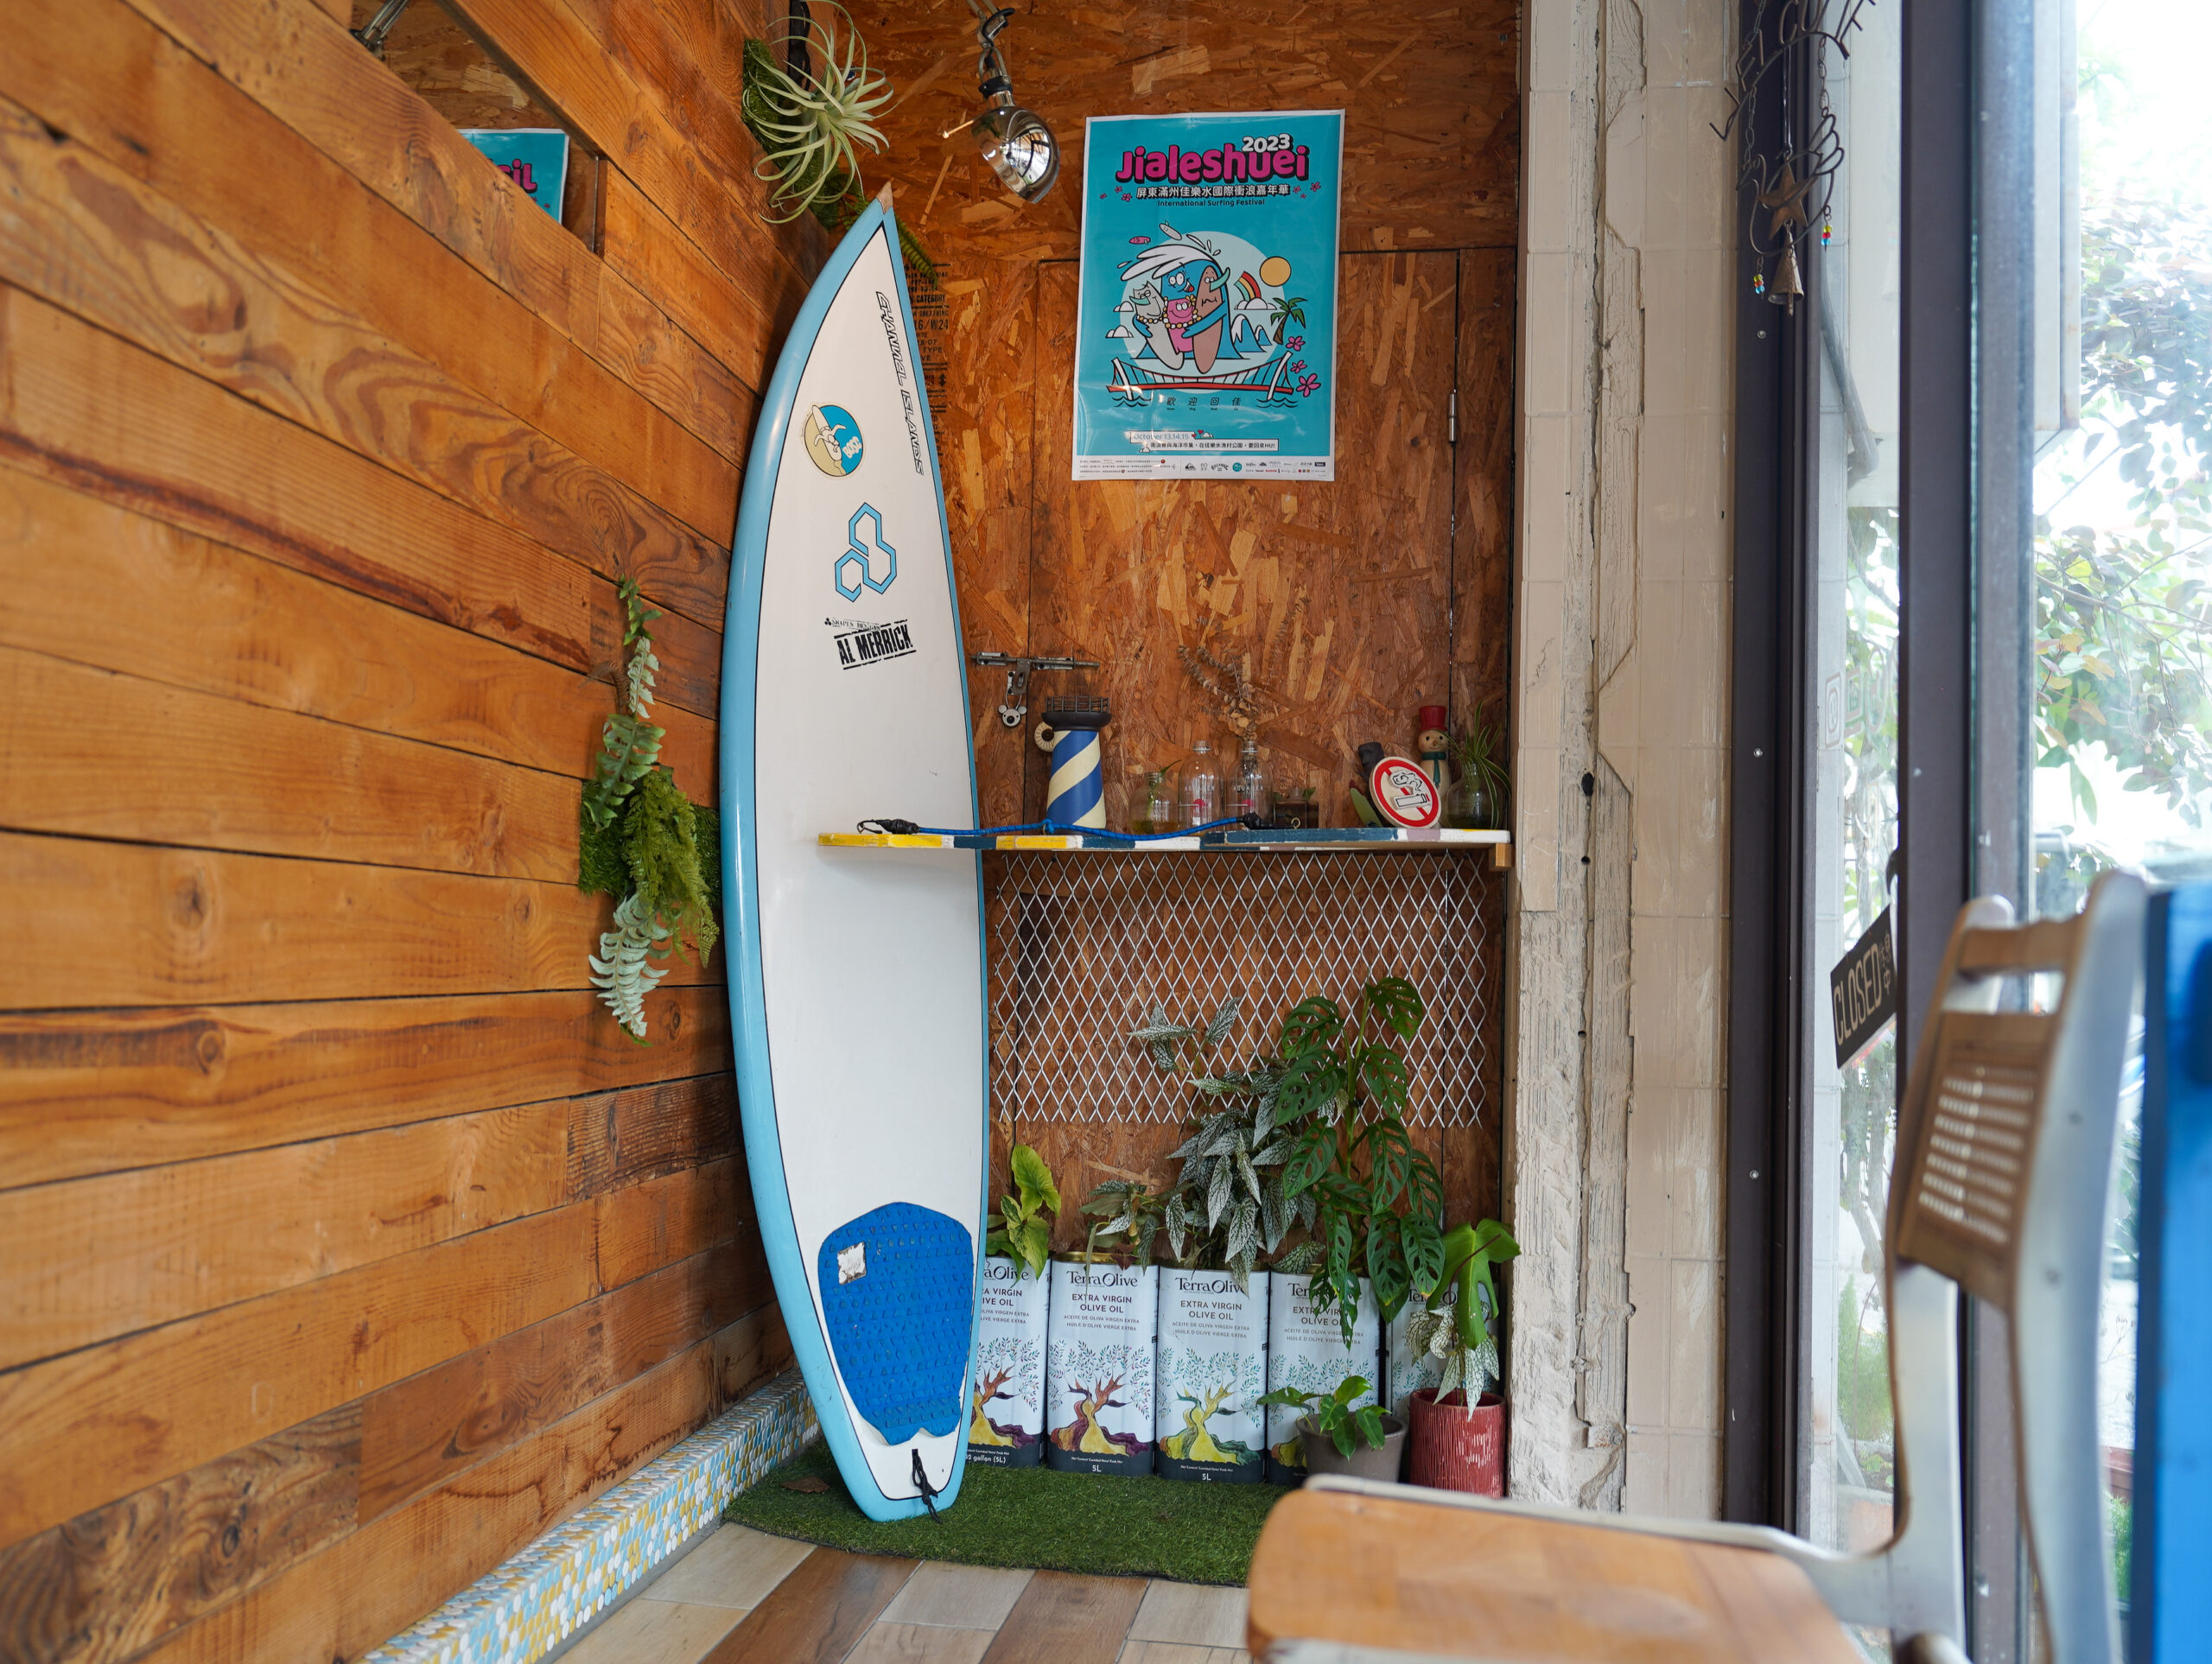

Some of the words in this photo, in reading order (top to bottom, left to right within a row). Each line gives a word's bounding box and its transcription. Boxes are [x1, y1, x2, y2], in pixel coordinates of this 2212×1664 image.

[1242, 133, 1293, 153] 2023
[1116, 143, 1310, 185] Jialeshuei
[1136, 184, 1291, 200] 屏東滿州佳樂水國際衝浪嘉年華
[1207, 199, 1234, 207] Surfing
[916, 294, 946, 304] CATEGORY
[875, 291, 907, 386] CHANNEL
[900, 390, 924, 475] ISLANDS
[836, 638, 856, 665] AL
[855, 624, 913, 661] MERRICK
[1833, 943, 1882, 1046] CLOSED
[993, 1287, 1022, 1297] VIRGIN
[982, 1297, 996, 1305] IVE
[1189, 1311, 1216, 1319] OLIVE
[1300, 1317, 1328, 1326] OLIVE
[994, 1456, 1006, 1464] (5L)
